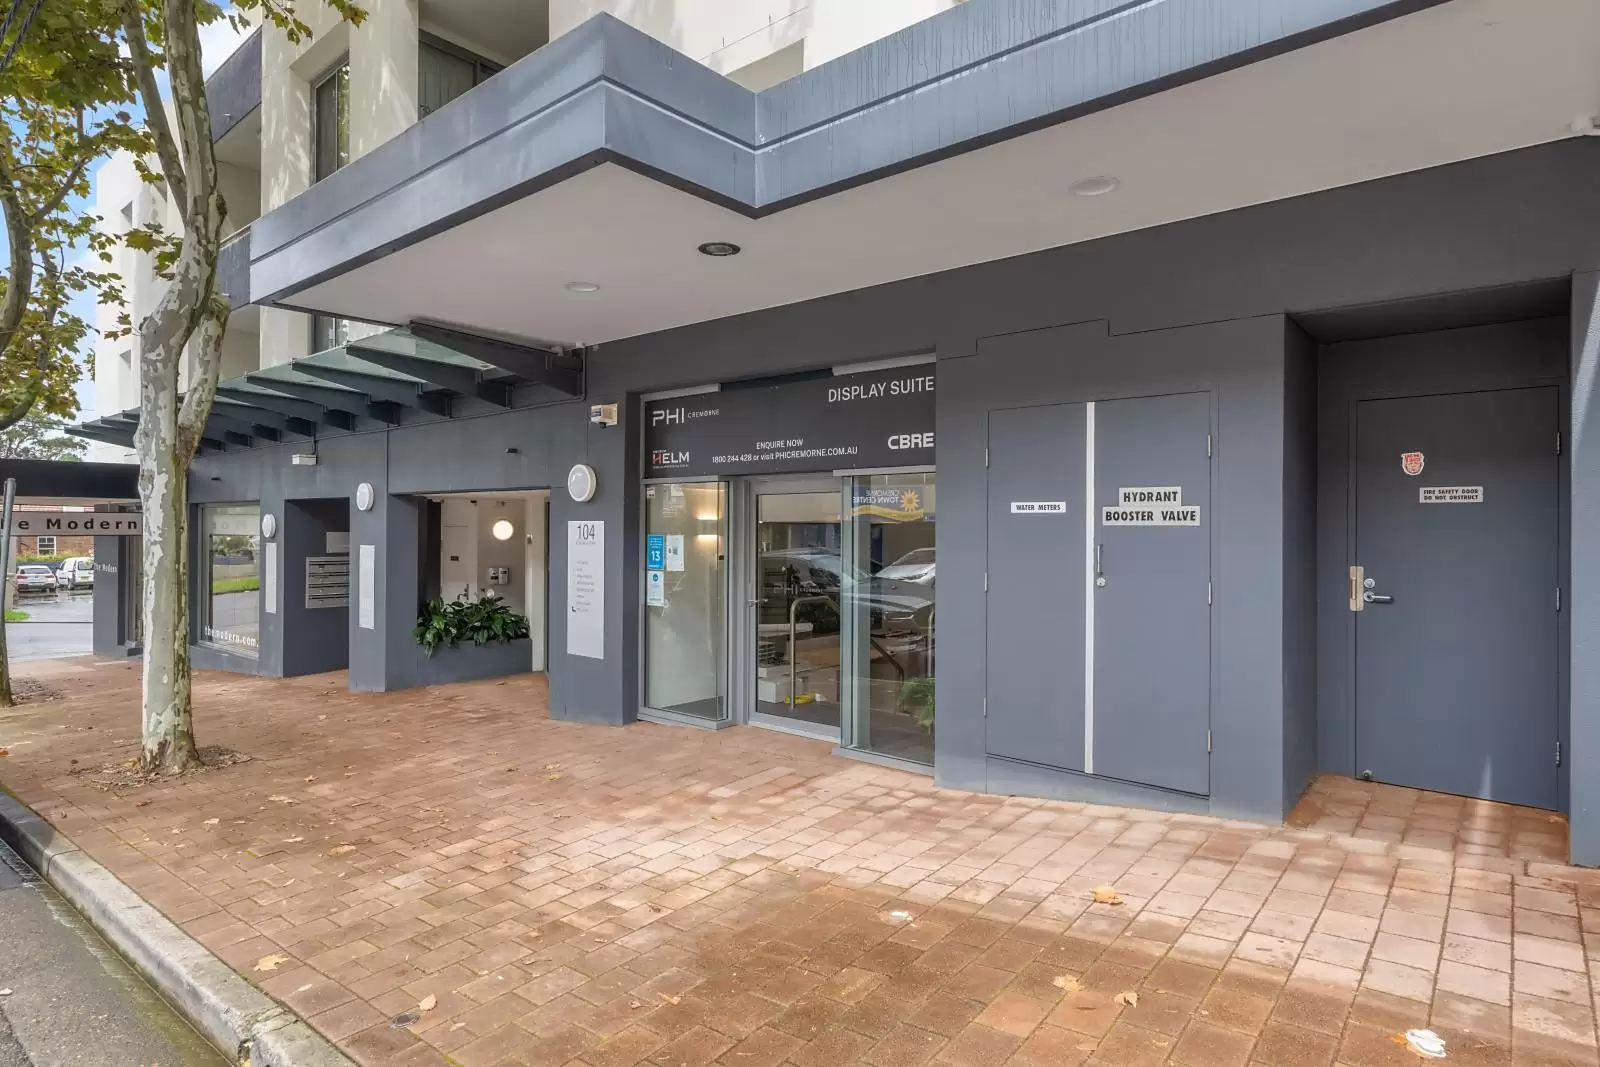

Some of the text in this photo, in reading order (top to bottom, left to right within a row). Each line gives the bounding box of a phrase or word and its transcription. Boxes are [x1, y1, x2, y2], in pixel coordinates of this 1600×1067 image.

[828, 376, 935, 402] DISPLAY SUITE
[652, 407, 720, 426] PHI CREMORNE
[756, 438, 804, 450] ENQUIRE NOW
[887, 432, 935, 450] CBRE
[652, 451, 690, 464] HELM
[712, 455, 726, 463] 1800
[727, 454, 739, 462] 244
[740, 453, 752, 461] 428
[761, 452, 774, 460] visit
[775, 446, 858, 460] PHICREMORNE.COM.AU
[1123, 491, 1178, 503] HYDRANT
[1016, 503, 1061, 511] WATER METERS
[1105, 511, 1196, 522] BOOSTER VALVE
[46, 518, 138, 530] Modern
[577, 523, 596, 541] 104
[651, 550, 661, 561] 13
